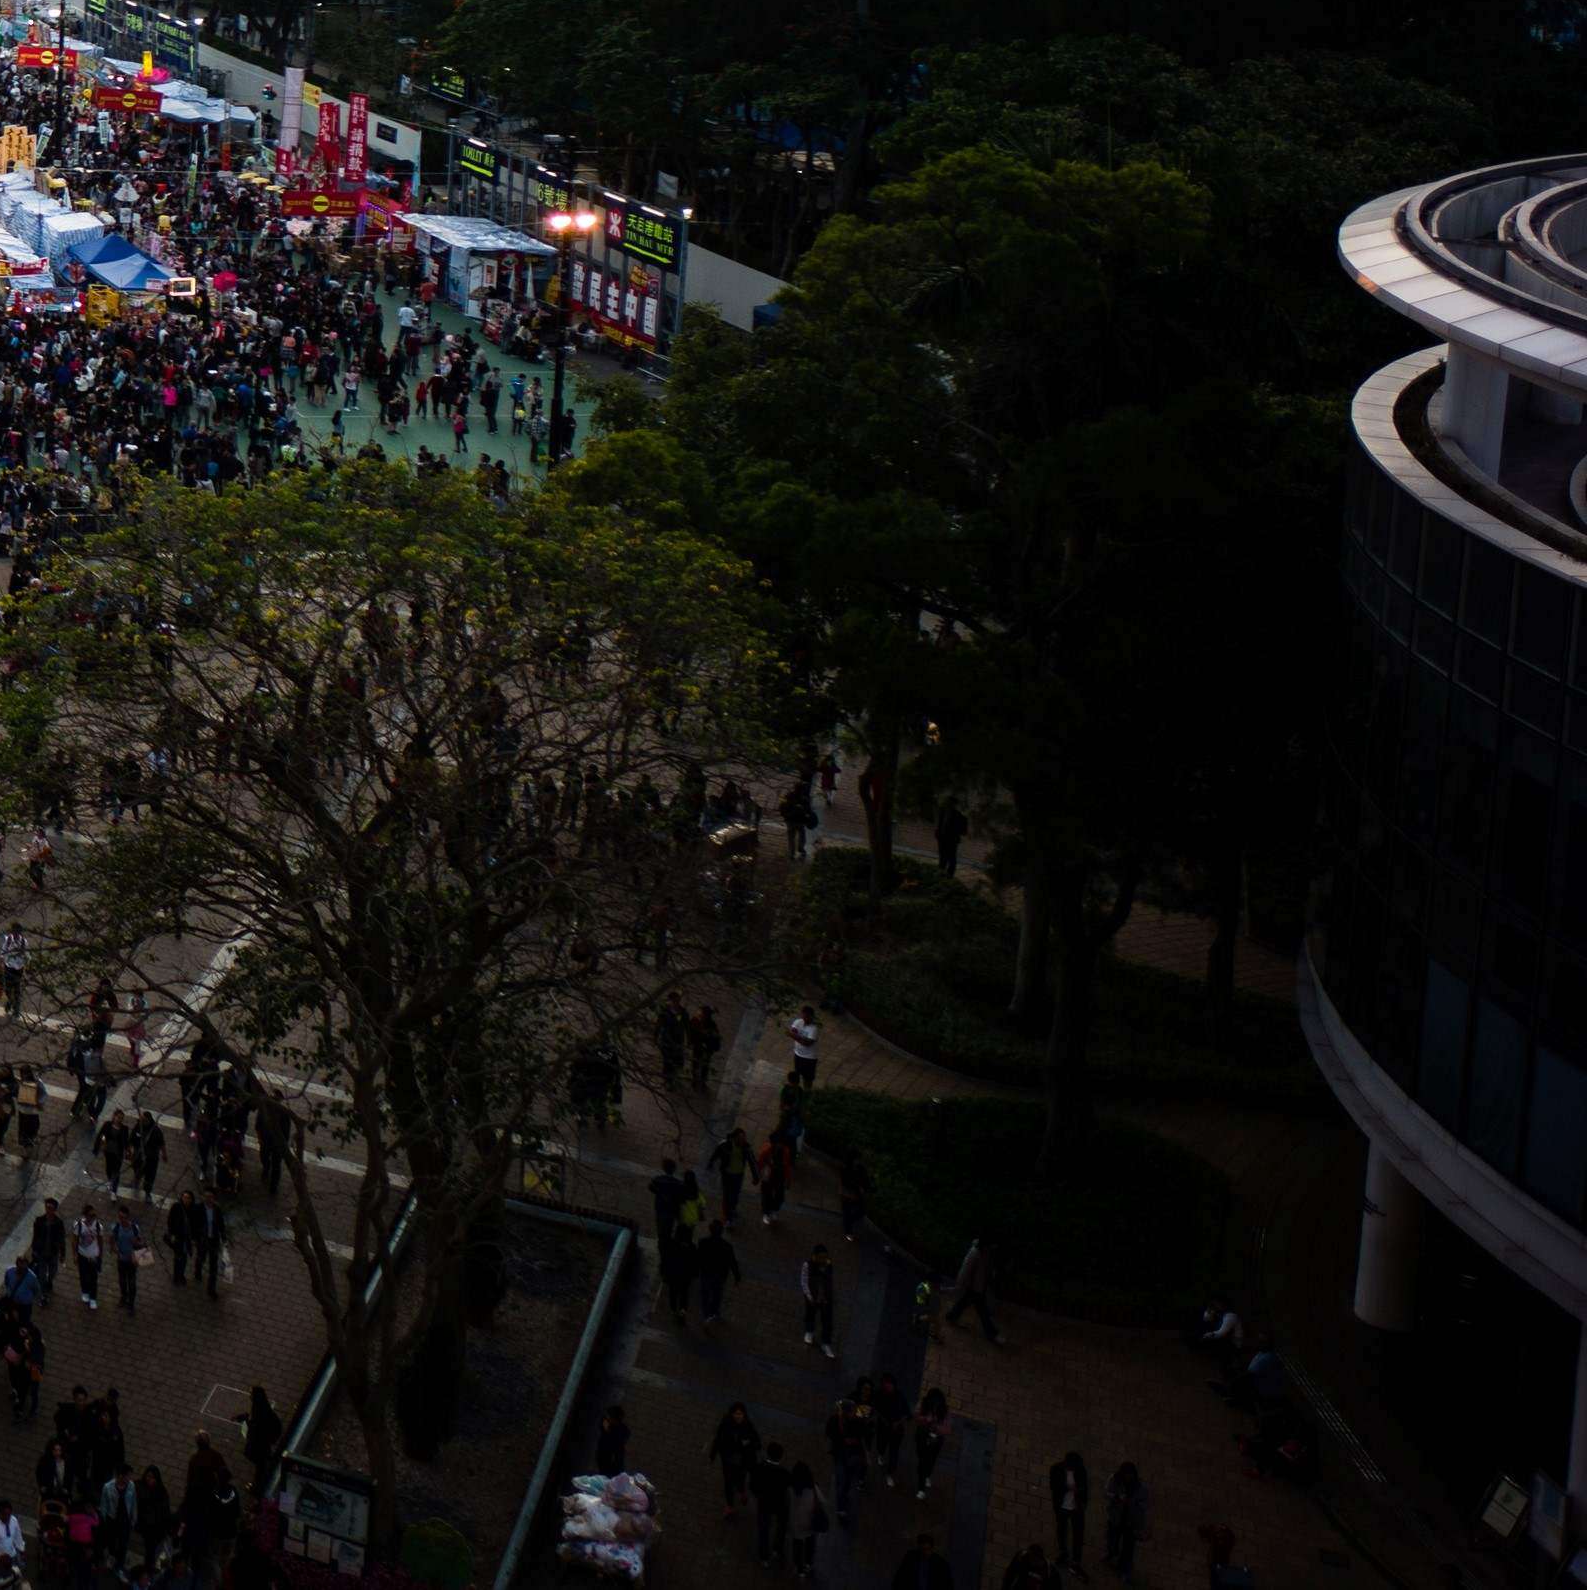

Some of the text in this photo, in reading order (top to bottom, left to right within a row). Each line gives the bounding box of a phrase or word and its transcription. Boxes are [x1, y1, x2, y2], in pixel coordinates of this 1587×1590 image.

[626, 213, 674, 243] 天后港鐵站
[626, 229, 675, 256] TIN HAU MTR
